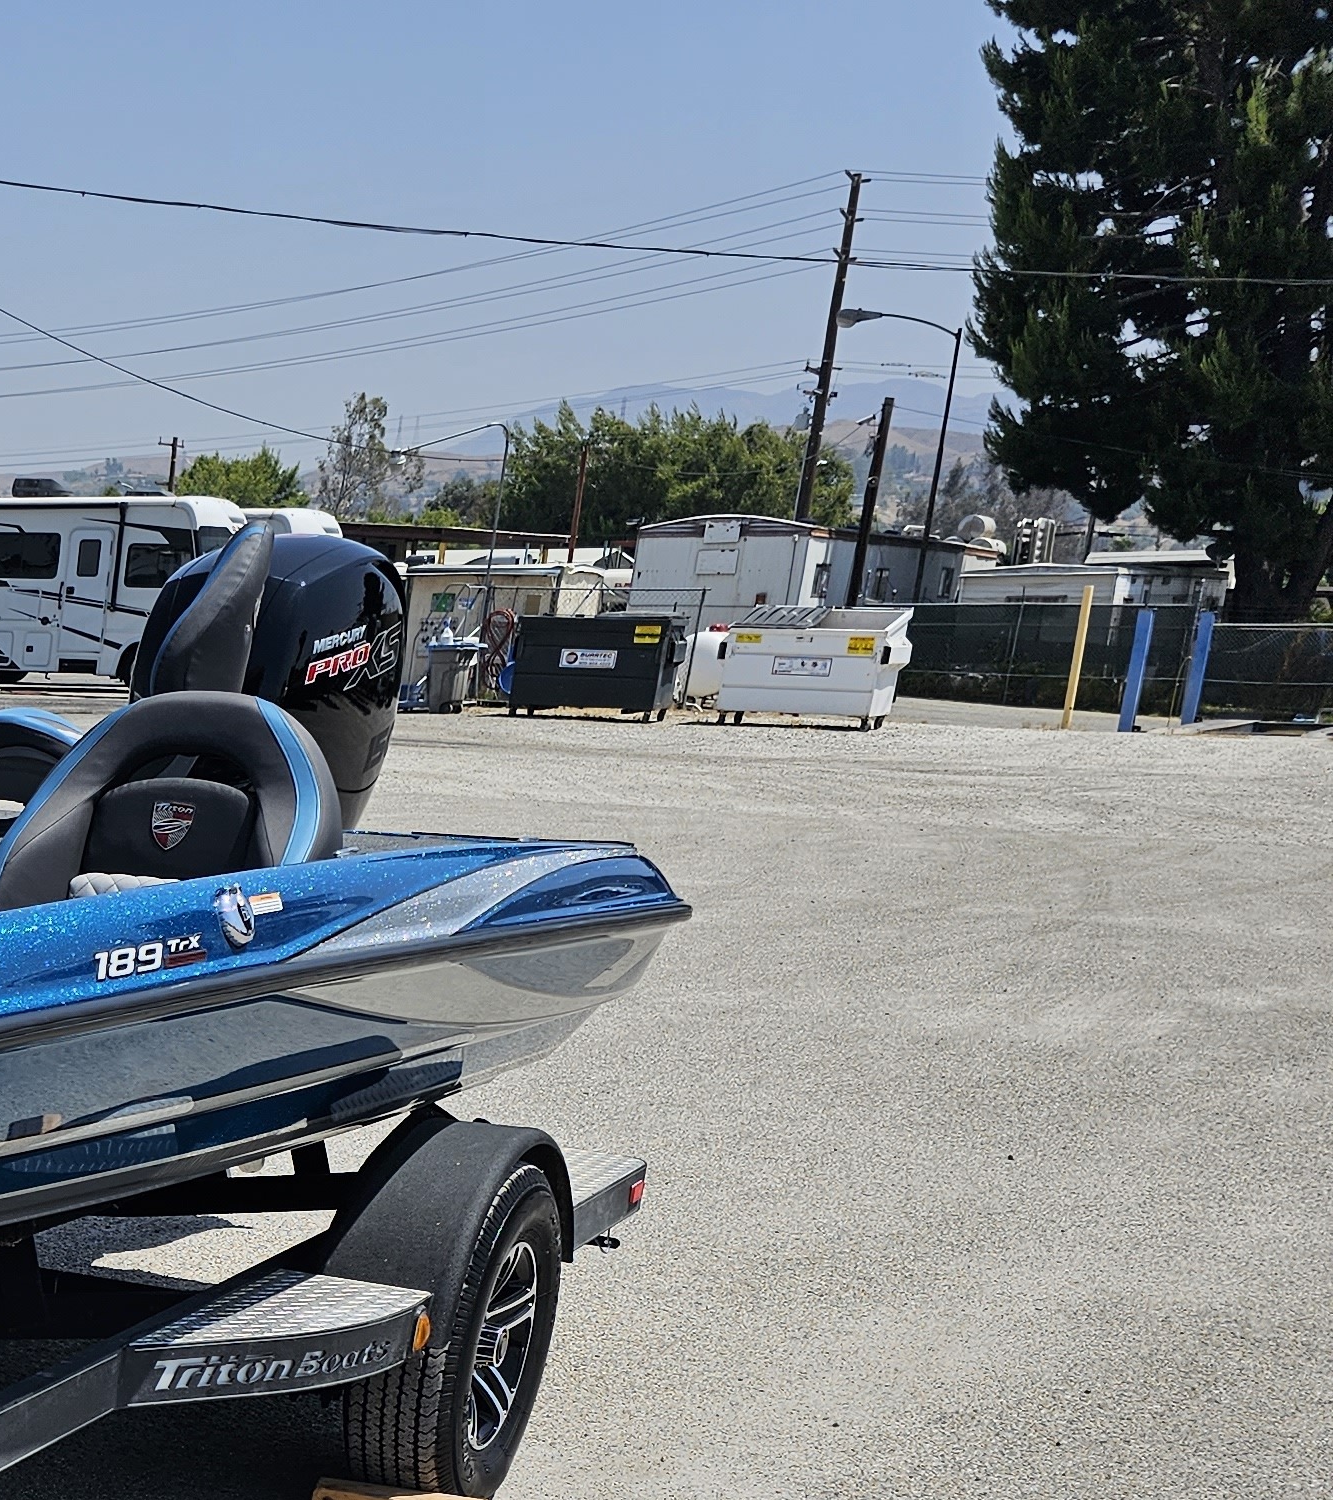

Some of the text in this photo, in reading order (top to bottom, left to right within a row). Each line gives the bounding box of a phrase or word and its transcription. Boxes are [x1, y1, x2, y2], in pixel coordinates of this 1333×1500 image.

[304, 620, 402, 692] PRO XS
[312, 624, 367, 655] MERCURY
[94, 940, 164, 982] 189
[154, 1340, 392, 1392] Triton Boats
